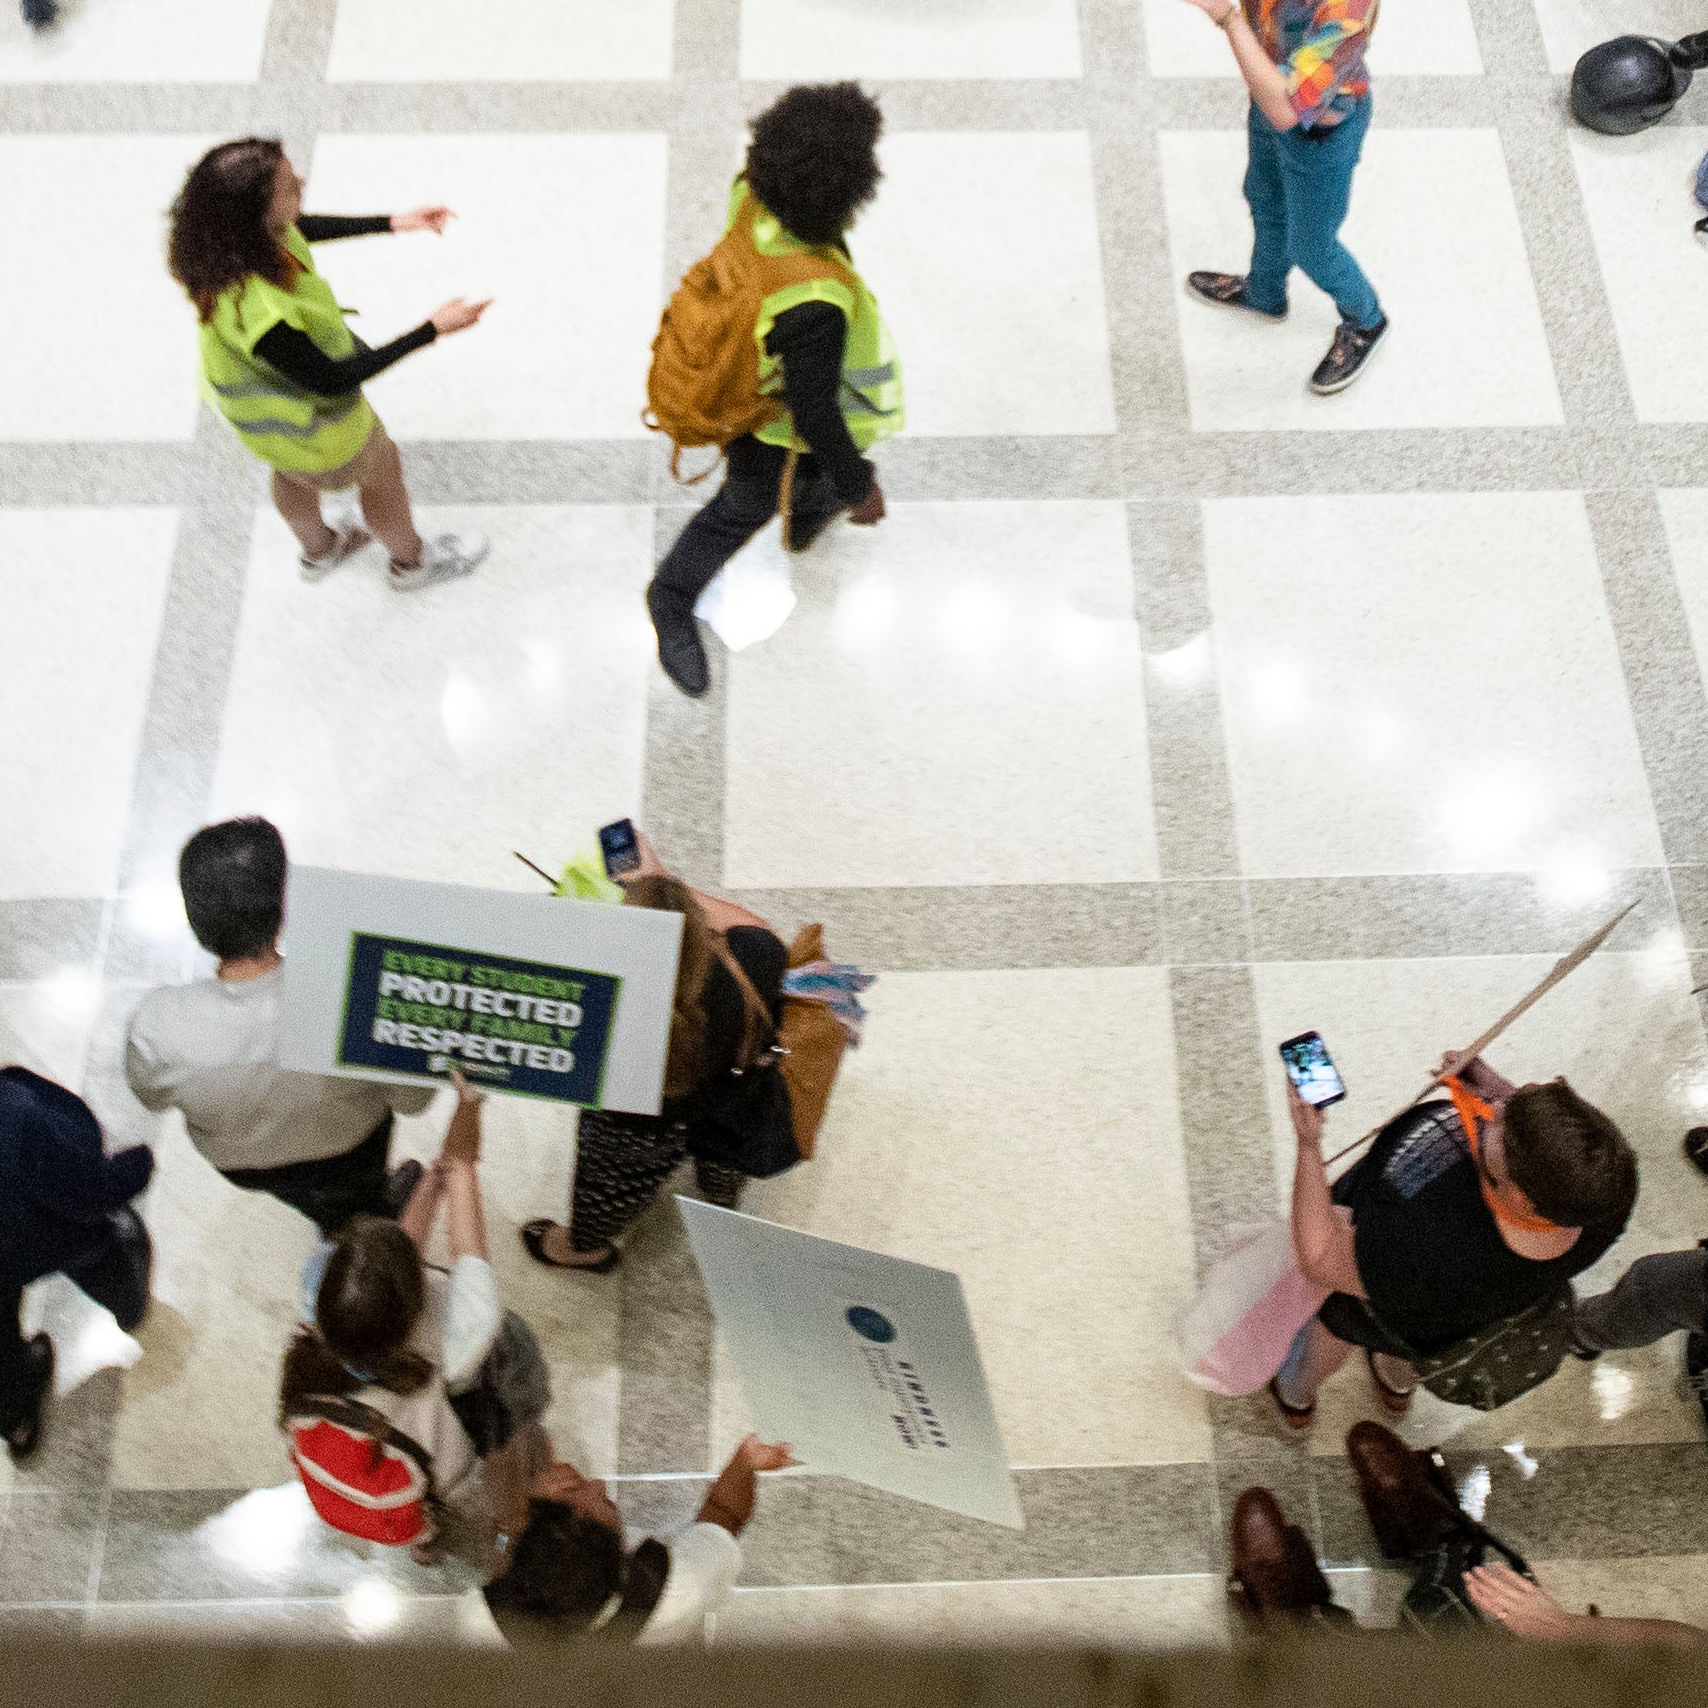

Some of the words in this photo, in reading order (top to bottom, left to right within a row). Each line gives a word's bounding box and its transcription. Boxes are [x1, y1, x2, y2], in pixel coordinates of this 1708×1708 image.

[379, 970, 584, 1028] PROTECTED
[382, 948, 467, 982] EVERY
[468, 965, 585, 1002] STUDENT
[372, 1018, 576, 1074] RESPECTED
[377, 994, 467, 1031] EVERY
[469, 1011, 579, 1048] FAMILY
